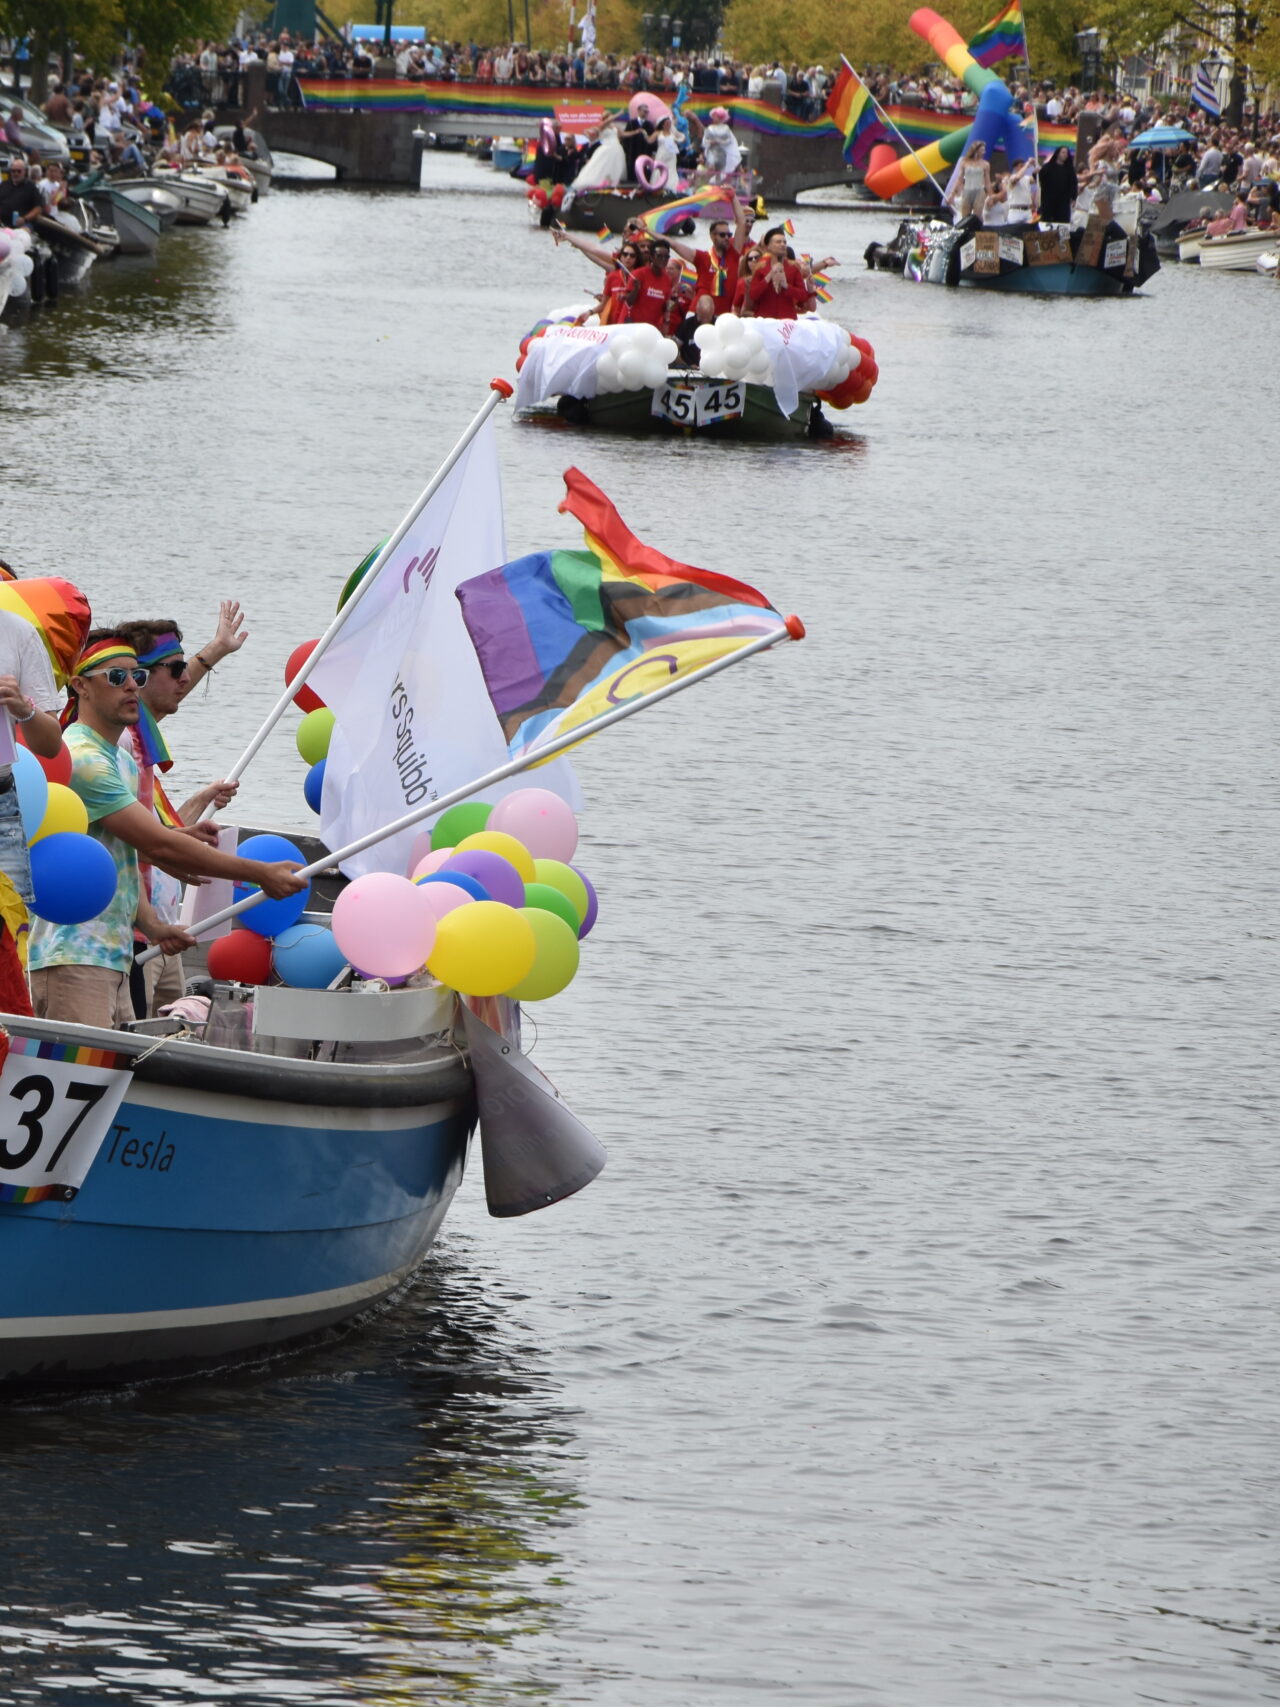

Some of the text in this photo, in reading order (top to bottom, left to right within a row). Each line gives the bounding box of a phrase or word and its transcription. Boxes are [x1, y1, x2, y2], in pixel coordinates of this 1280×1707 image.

[660, 389, 692, 420] 45
[703, 385, 741, 413] 45
[107, 1124, 176, 1172] Tesla
